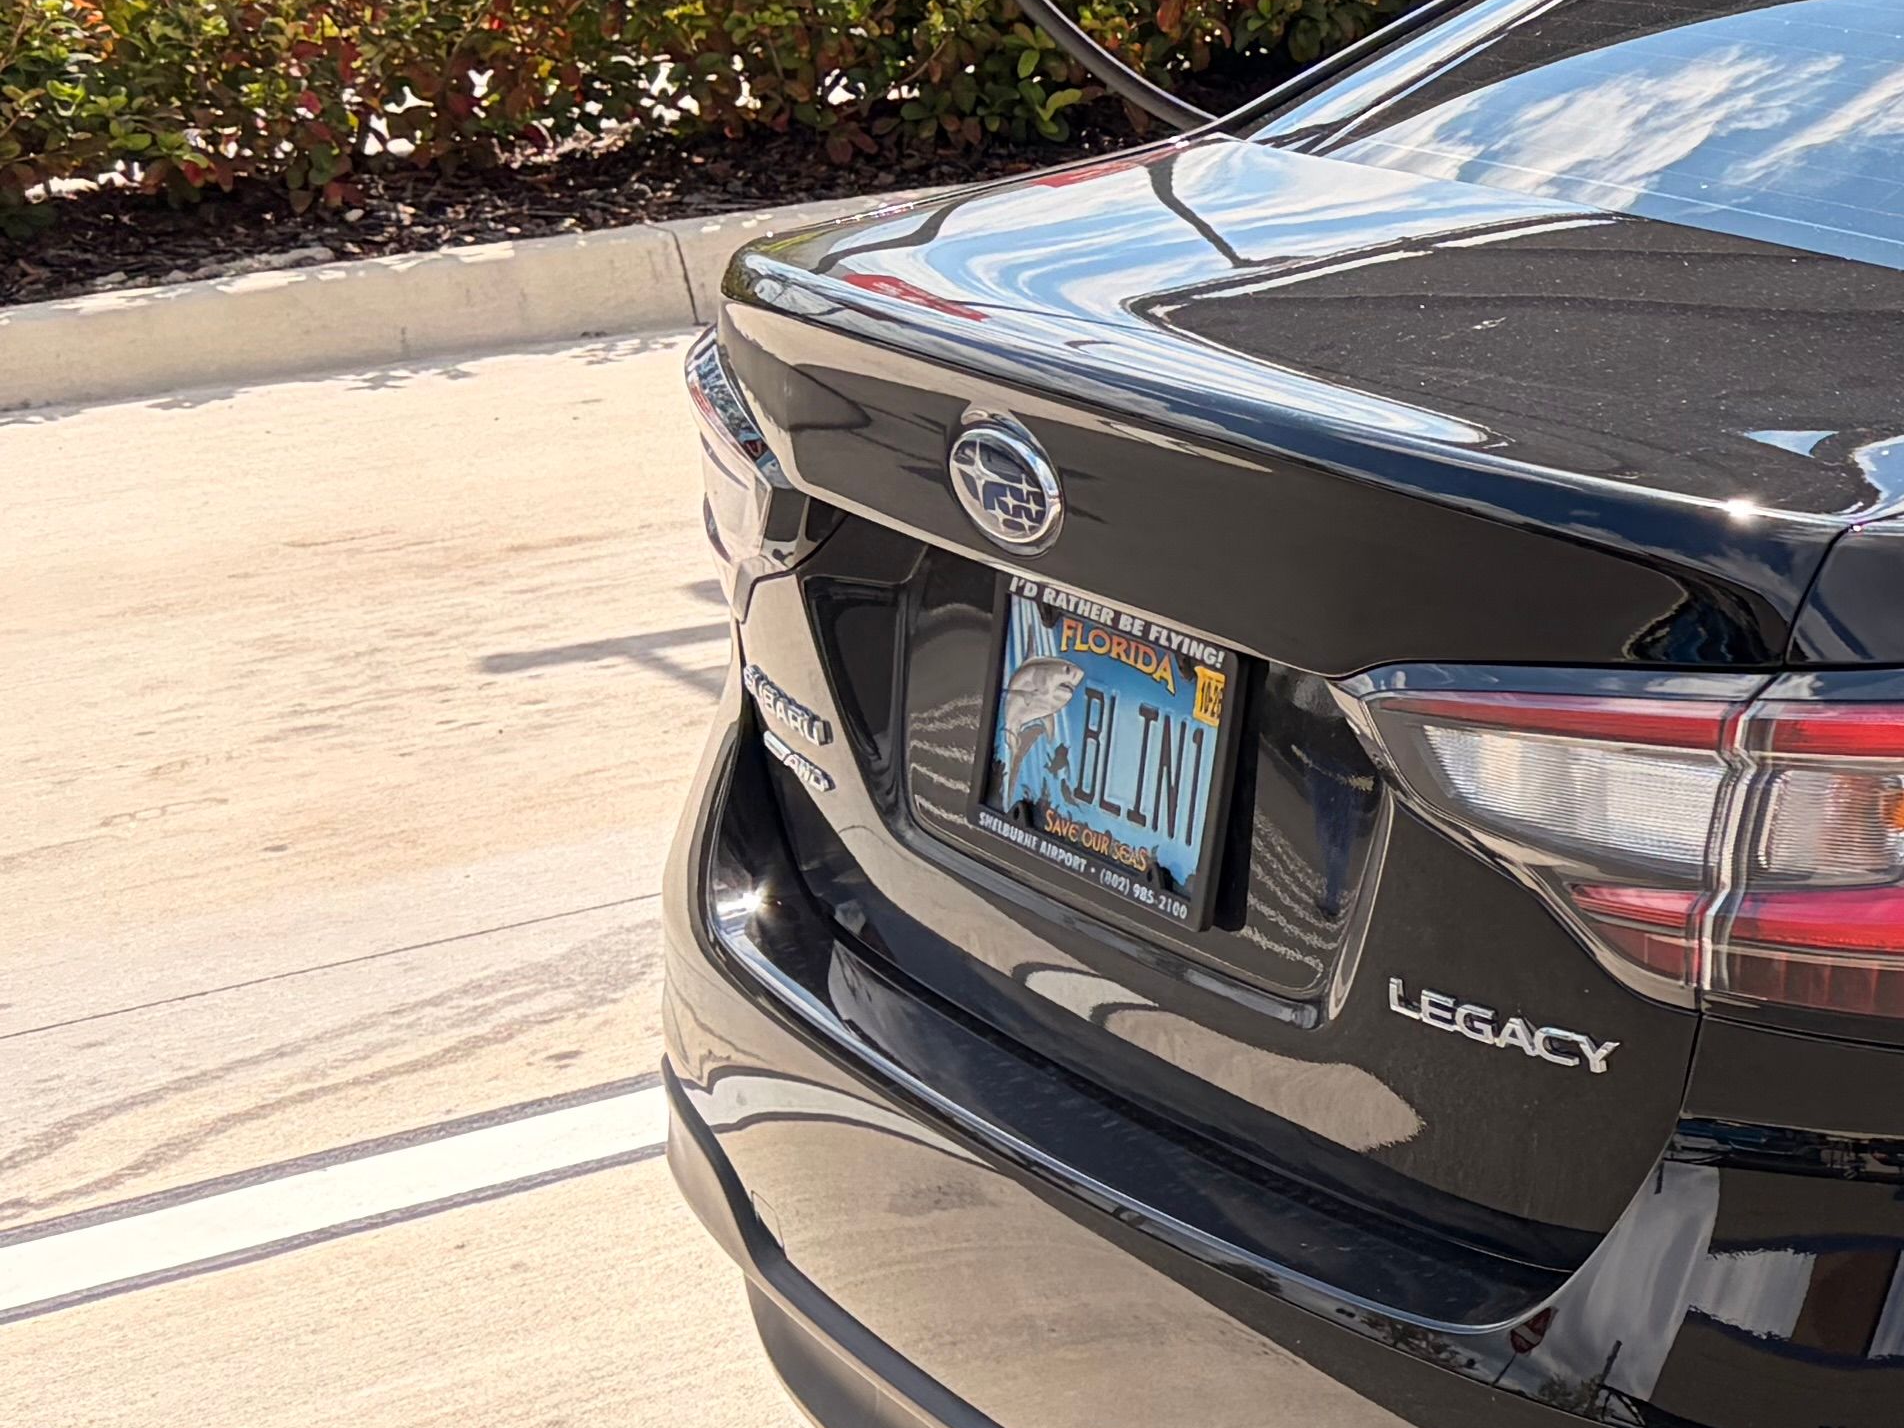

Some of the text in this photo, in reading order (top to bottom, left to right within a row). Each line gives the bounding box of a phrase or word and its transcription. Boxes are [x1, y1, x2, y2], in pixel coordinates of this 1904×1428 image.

[1009, 577, 1225, 668] I'D RATHER BE FLYING!
[1060, 619, 1176, 695] FLORIDA
[744, 664, 834, 746] SUBARU
[978, 812, 1188, 919] SHELBURNE AIRPORT (802) 985-2100
[1044, 809, 1149, 872] SAVE OUR SEAS
[1389, 977, 1620, 1073] LEGACY
